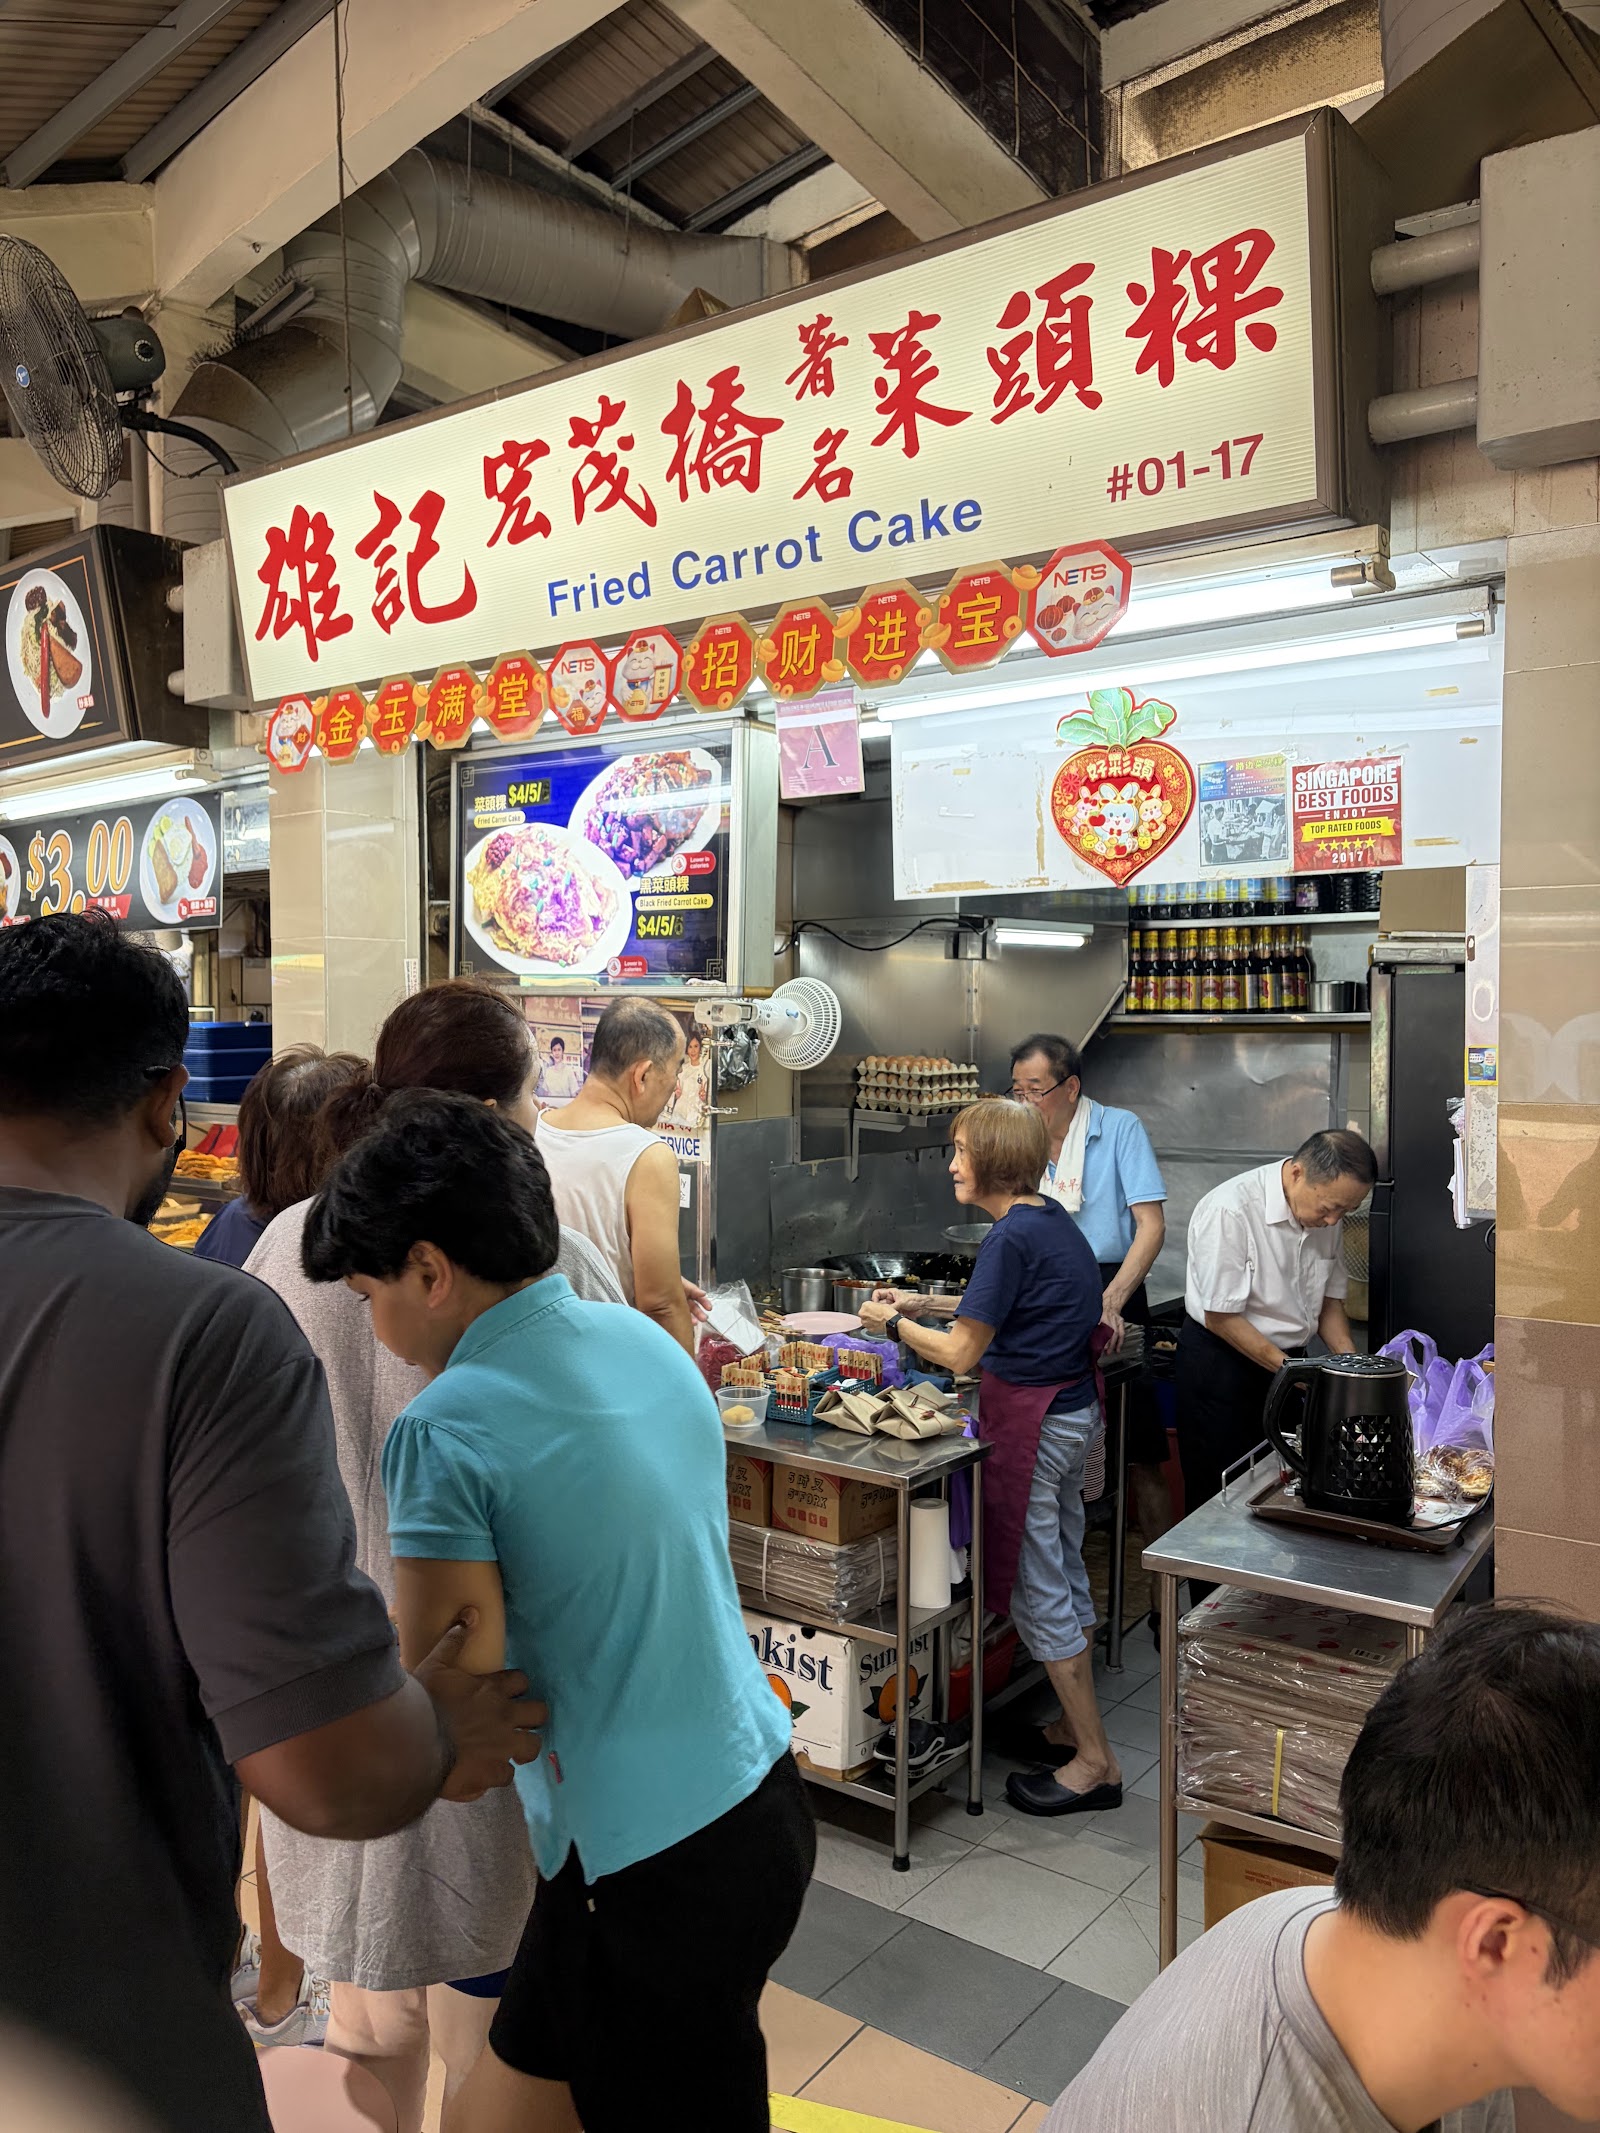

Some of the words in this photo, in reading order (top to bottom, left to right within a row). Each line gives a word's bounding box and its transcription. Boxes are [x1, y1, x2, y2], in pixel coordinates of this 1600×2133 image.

[1107, 433, 1264, 502] #01-17
[548, 561, 651, 617] Fried
[672, 528, 821, 590] Carrot
[848, 499, 982, 553] Cake
[970, 576, 991, 587] NETS
[1054, 563, 1107, 588] NETS
[877, 595, 897, 605] NETS
[793, 612, 811, 622] NETS
[715, 627, 732, 635] NETS
[561, 658, 595, 675] NETS
[800, 724, 840, 770] A
[1295, 763, 1398, 791] SINGAPORE
[1298, 791, 1336, 809] BEST
[1341, 785, 1394, 805] FOODS
[478, 816, 491, 825] Fried
[492, 815, 507, 823] Carrot
[508, 814, 521, 822] Cake
[1325, 807, 1366, 820] ENJOY
[1310, 825, 1325, 834] TOP
[1328, 823, 1353, 833] RATED
[1355, 821, 1382, 831] FOODS
[1332, 851, 1364, 863] 2017
[26, 815, 134, 916] $3.00
[640, 875, 690, 894] 黑菜頭粿
[640, 899, 655, 907] Black
[657, 898, 672, 906] Fried
[674, 898, 692, 906] Carrot
[693, 897, 708, 905] Cake
